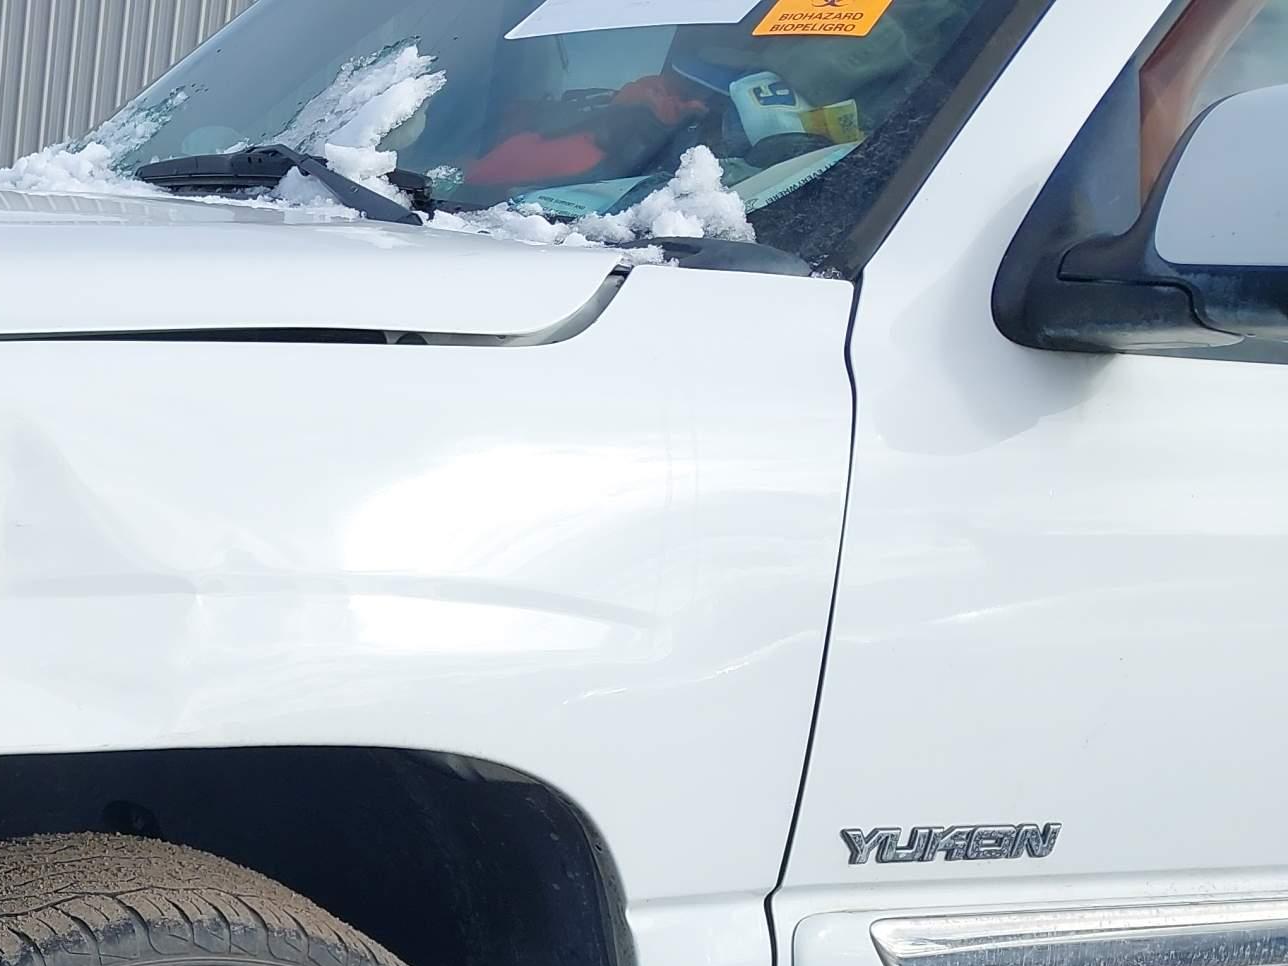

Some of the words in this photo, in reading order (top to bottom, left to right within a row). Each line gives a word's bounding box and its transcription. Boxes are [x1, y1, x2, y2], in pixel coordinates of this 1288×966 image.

[778, 12, 864, 21] BIOHAZARD
[769, 23, 856, 32] BIOPELIGRO
[840, 823, 1062, 865] YUKON
